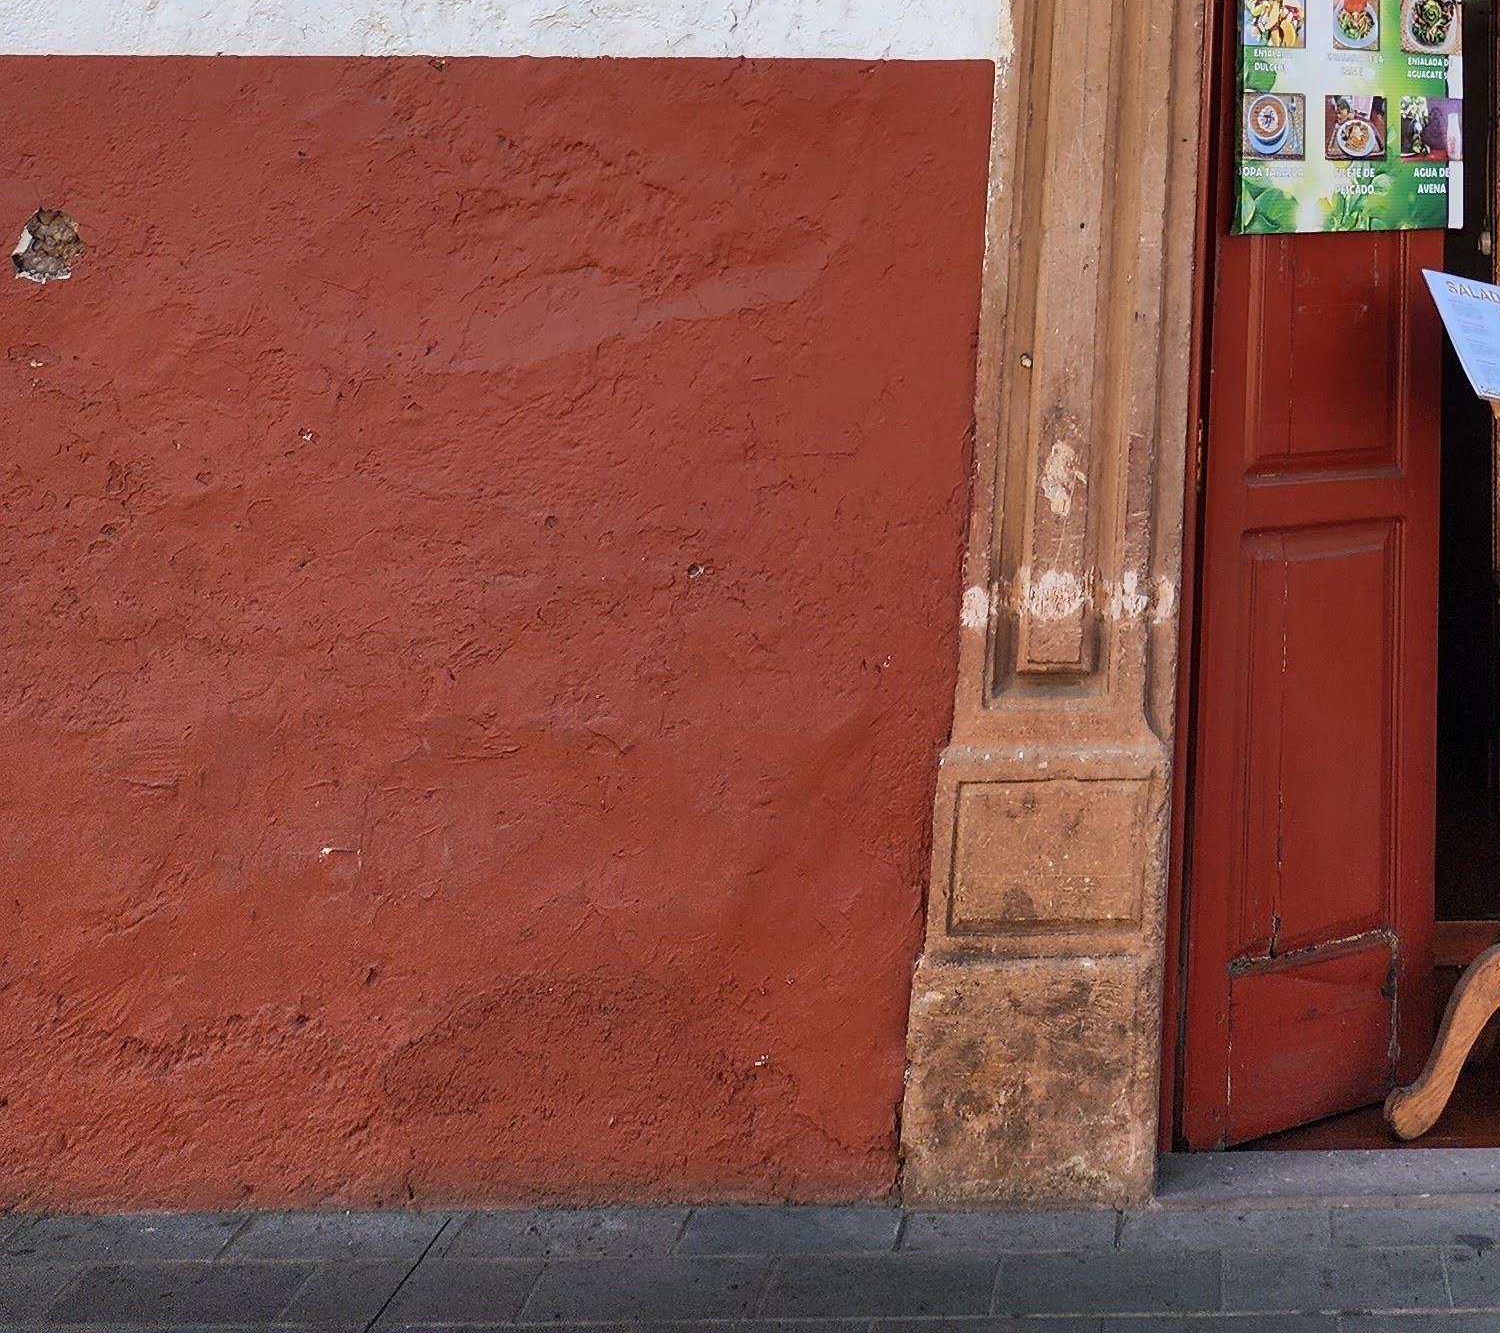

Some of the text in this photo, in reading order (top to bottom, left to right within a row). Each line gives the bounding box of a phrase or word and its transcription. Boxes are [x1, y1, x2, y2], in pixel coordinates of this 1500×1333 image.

[1407, 57, 1443, 67] ENSALADA
[1407, 70, 1443, 80] AGUACATE
[1362, 168, 1375, 178] DE
[1413, 167, 1450, 178] AGUA DE
[1335, 184, 1375, 195] PESCADO
[1417, 183, 1447, 194] AVENA
